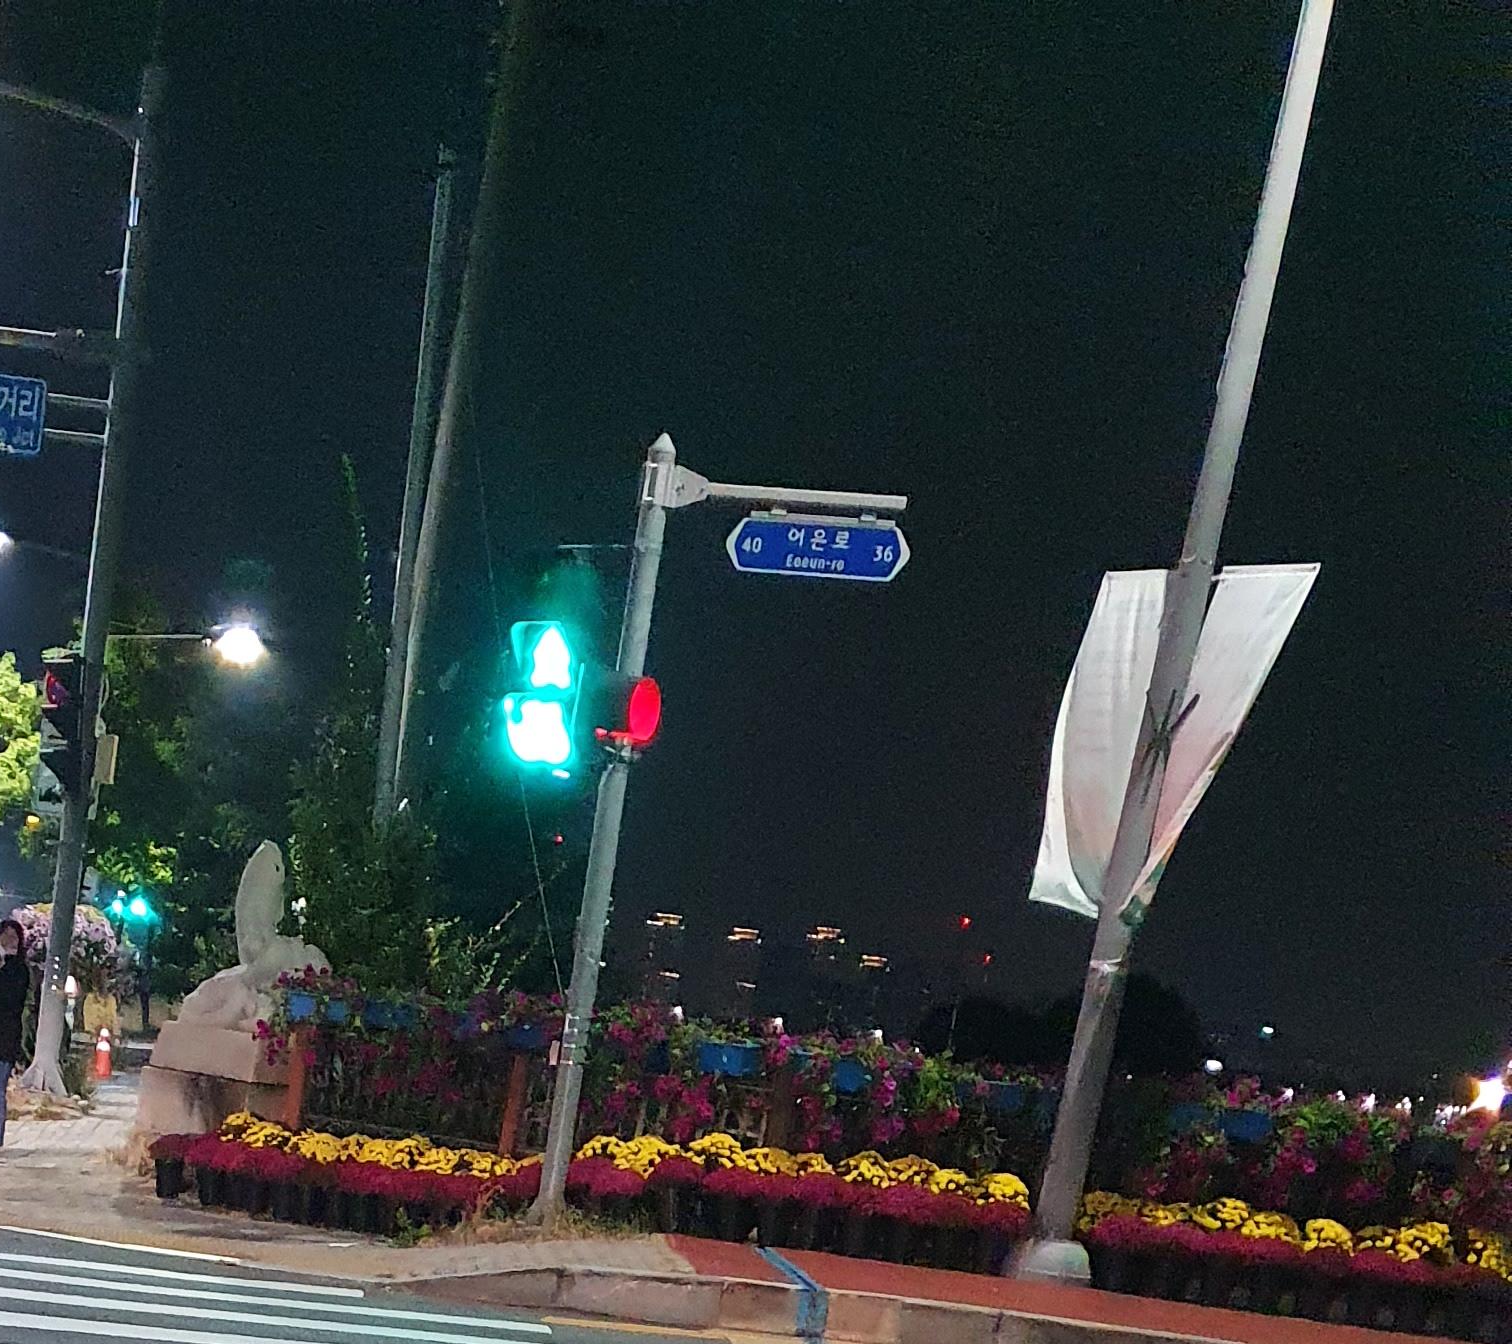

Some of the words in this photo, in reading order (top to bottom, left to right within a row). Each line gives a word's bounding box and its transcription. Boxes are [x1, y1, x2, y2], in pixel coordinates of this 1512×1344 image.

[740, 536, 763, 554] 40
[787, 527, 851, 551] 어은로
[785, 553, 846, 571] Eoeun-ro
[872, 545, 894, 563] 36
